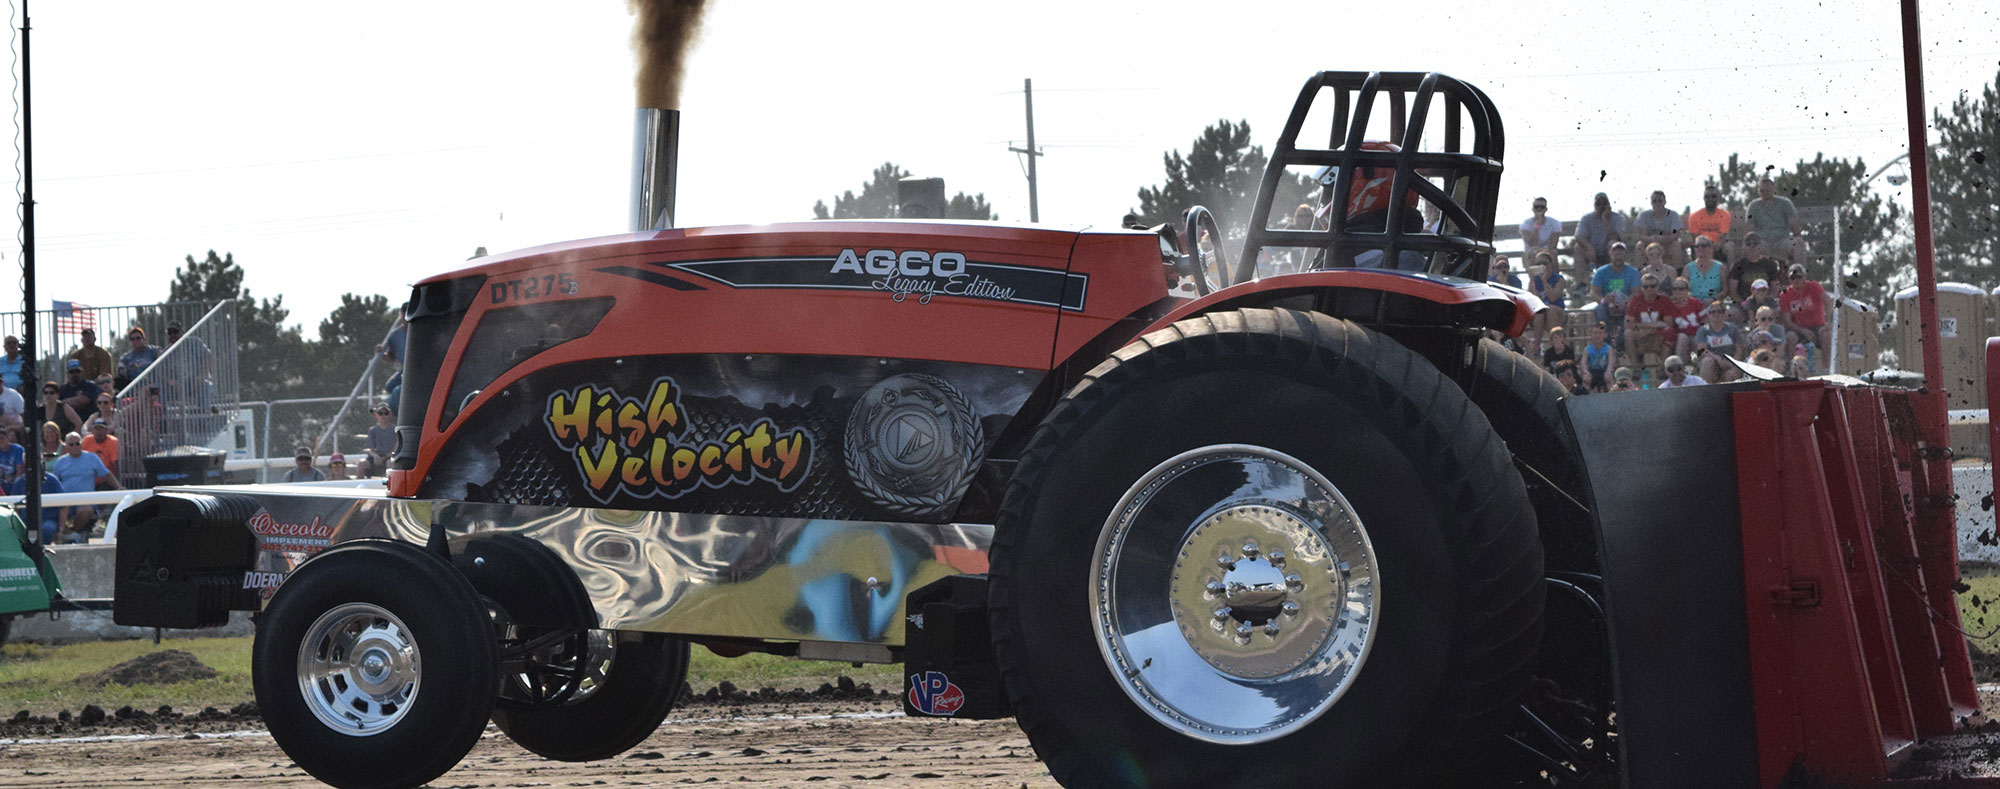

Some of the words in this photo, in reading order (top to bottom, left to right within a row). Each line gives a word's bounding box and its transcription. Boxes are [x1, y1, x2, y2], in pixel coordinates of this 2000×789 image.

[830, 249, 966, 277] AGCO
[872, 267, 936, 305] Legacy
[944, 273, 1016, 300] Edition
[550, 382, 678, 447] High
[578, 423, 802, 490] Velocity
[249, 512, 331, 537] Osceola
[266, 536, 329, 545] IMPLEMENT
[911, 671, 949, 715] VP
[934, 695, 964, 709] Racing
